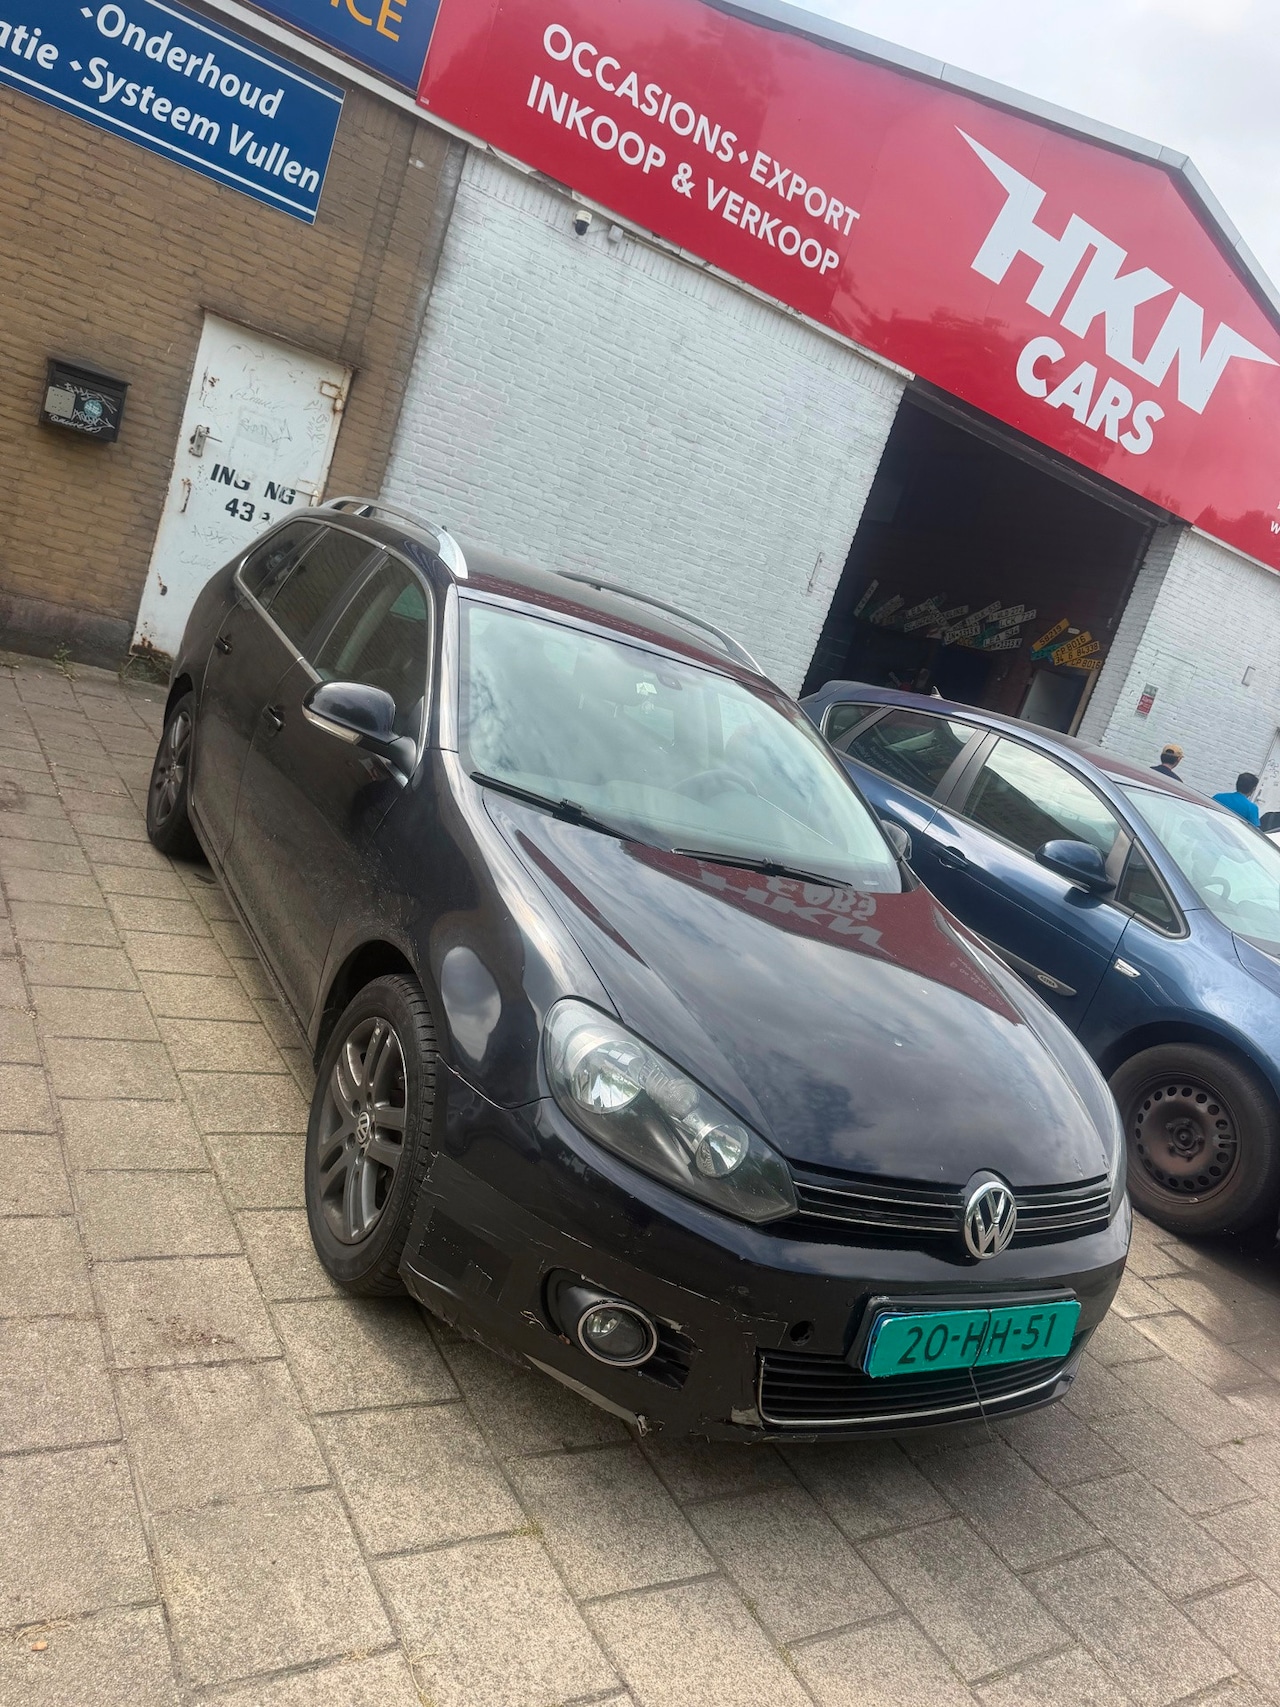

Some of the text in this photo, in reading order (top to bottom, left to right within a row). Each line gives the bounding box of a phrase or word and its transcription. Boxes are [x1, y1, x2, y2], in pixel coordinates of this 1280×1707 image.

[82, 57, 221, 145] Systeem
[227, 123, 320, 193] Vullen
[96, 4, 284, 119] Onderhoud
[543, 23, 860, 236] OCCASIONS EXPORT
[526, 74, 840, 275] INKOOP & VERKOOP
[954, 124, 1280, 415] HKN
[1015, 336, 1165, 455] CARS
[898, 1313, 1057, 1364] 20-HH-51
